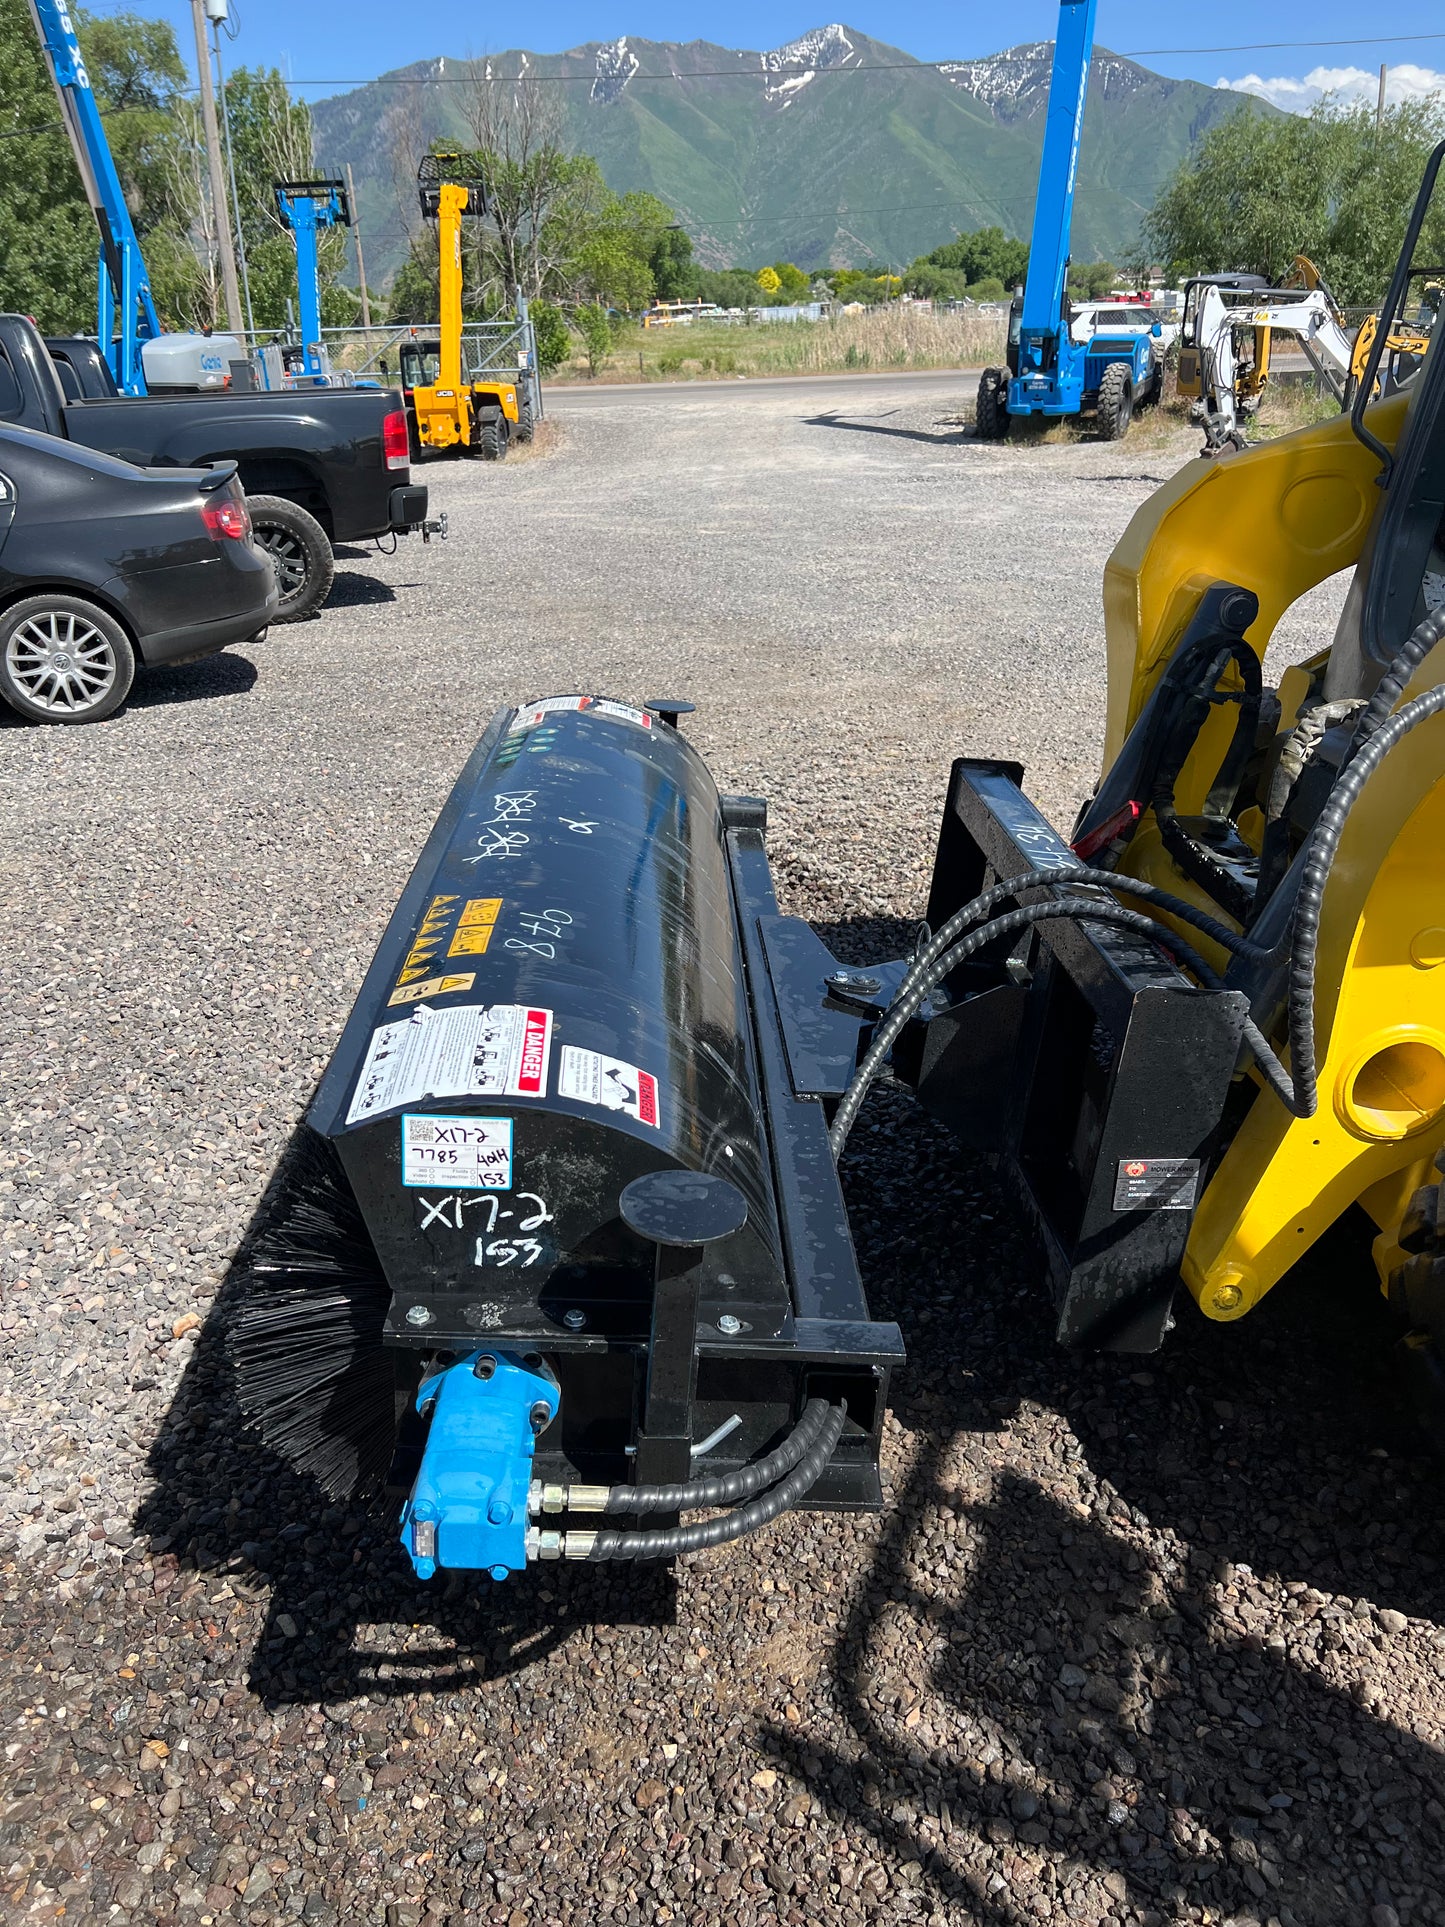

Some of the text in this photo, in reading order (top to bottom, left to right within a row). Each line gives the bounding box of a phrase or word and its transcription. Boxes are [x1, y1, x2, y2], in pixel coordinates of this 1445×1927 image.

[521, 1031, 544, 1079] DANGER
[434, 1126, 490, 1143] X17-2
[412, 1148, 458, 1164] 7785
[479, 1173, 506, 1187] 153
[418, 1192, 553, 1233] X17-2
[475, 1237, 543, 1268] 153
